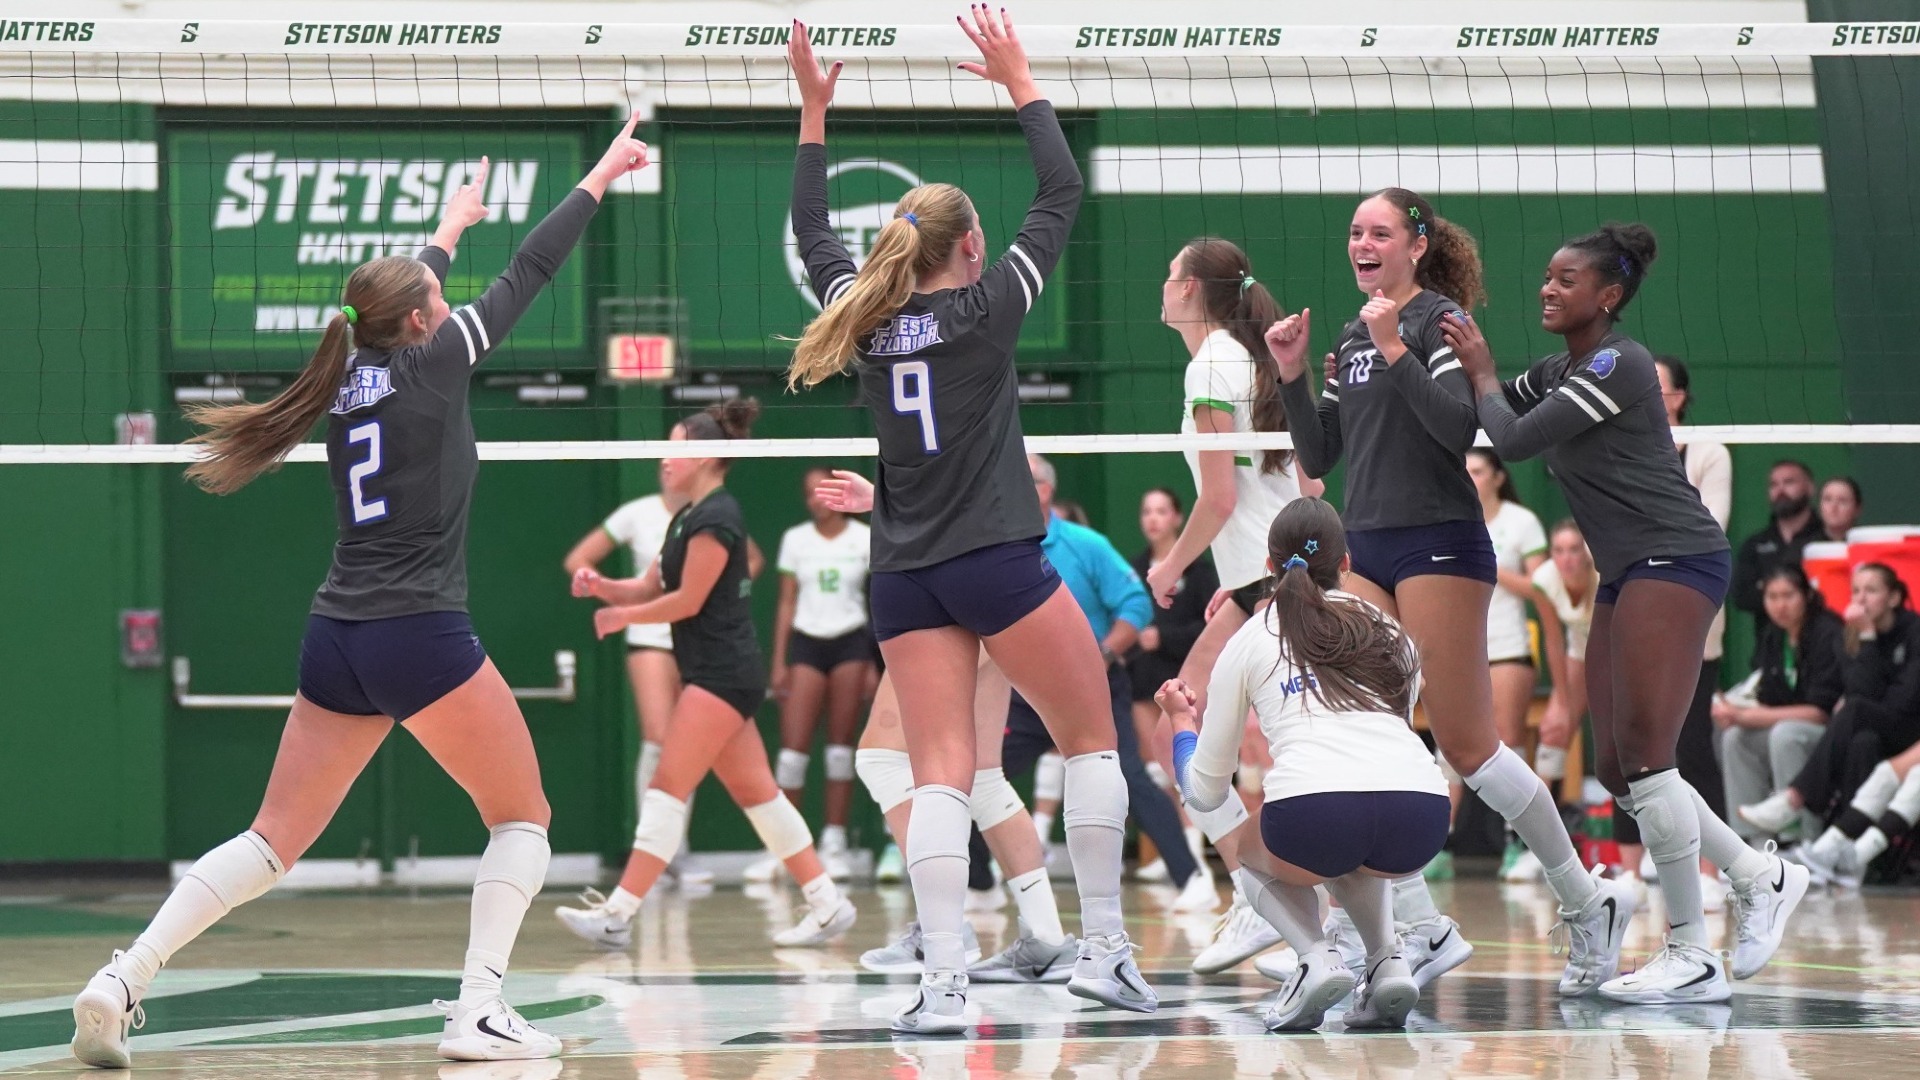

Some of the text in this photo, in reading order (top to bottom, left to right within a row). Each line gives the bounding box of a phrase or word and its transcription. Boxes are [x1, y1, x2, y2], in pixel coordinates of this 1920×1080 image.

[284, 22, 502, 46] STETSON HATTERS
[685, 25, 897, 47] STETSON ATTERS
[1075, 26, 1282, 48] STETSON HATTERS
[1457, 26, 1660, 48] STETSON HATTERS
[213, 150, 539, 230] STETSON
[297, 232, 457, 265] HATTE
[620, 336, 664, 377] EXIT
[1348, 348, 1378, 385] 10
[350, 368, 386, 392] EST
[891, 360, 940, 453] 9
[346, 420, 388, 524] 2
[819, 568, 840, 593] 12
[1279, 672, 1317, 698] WES
